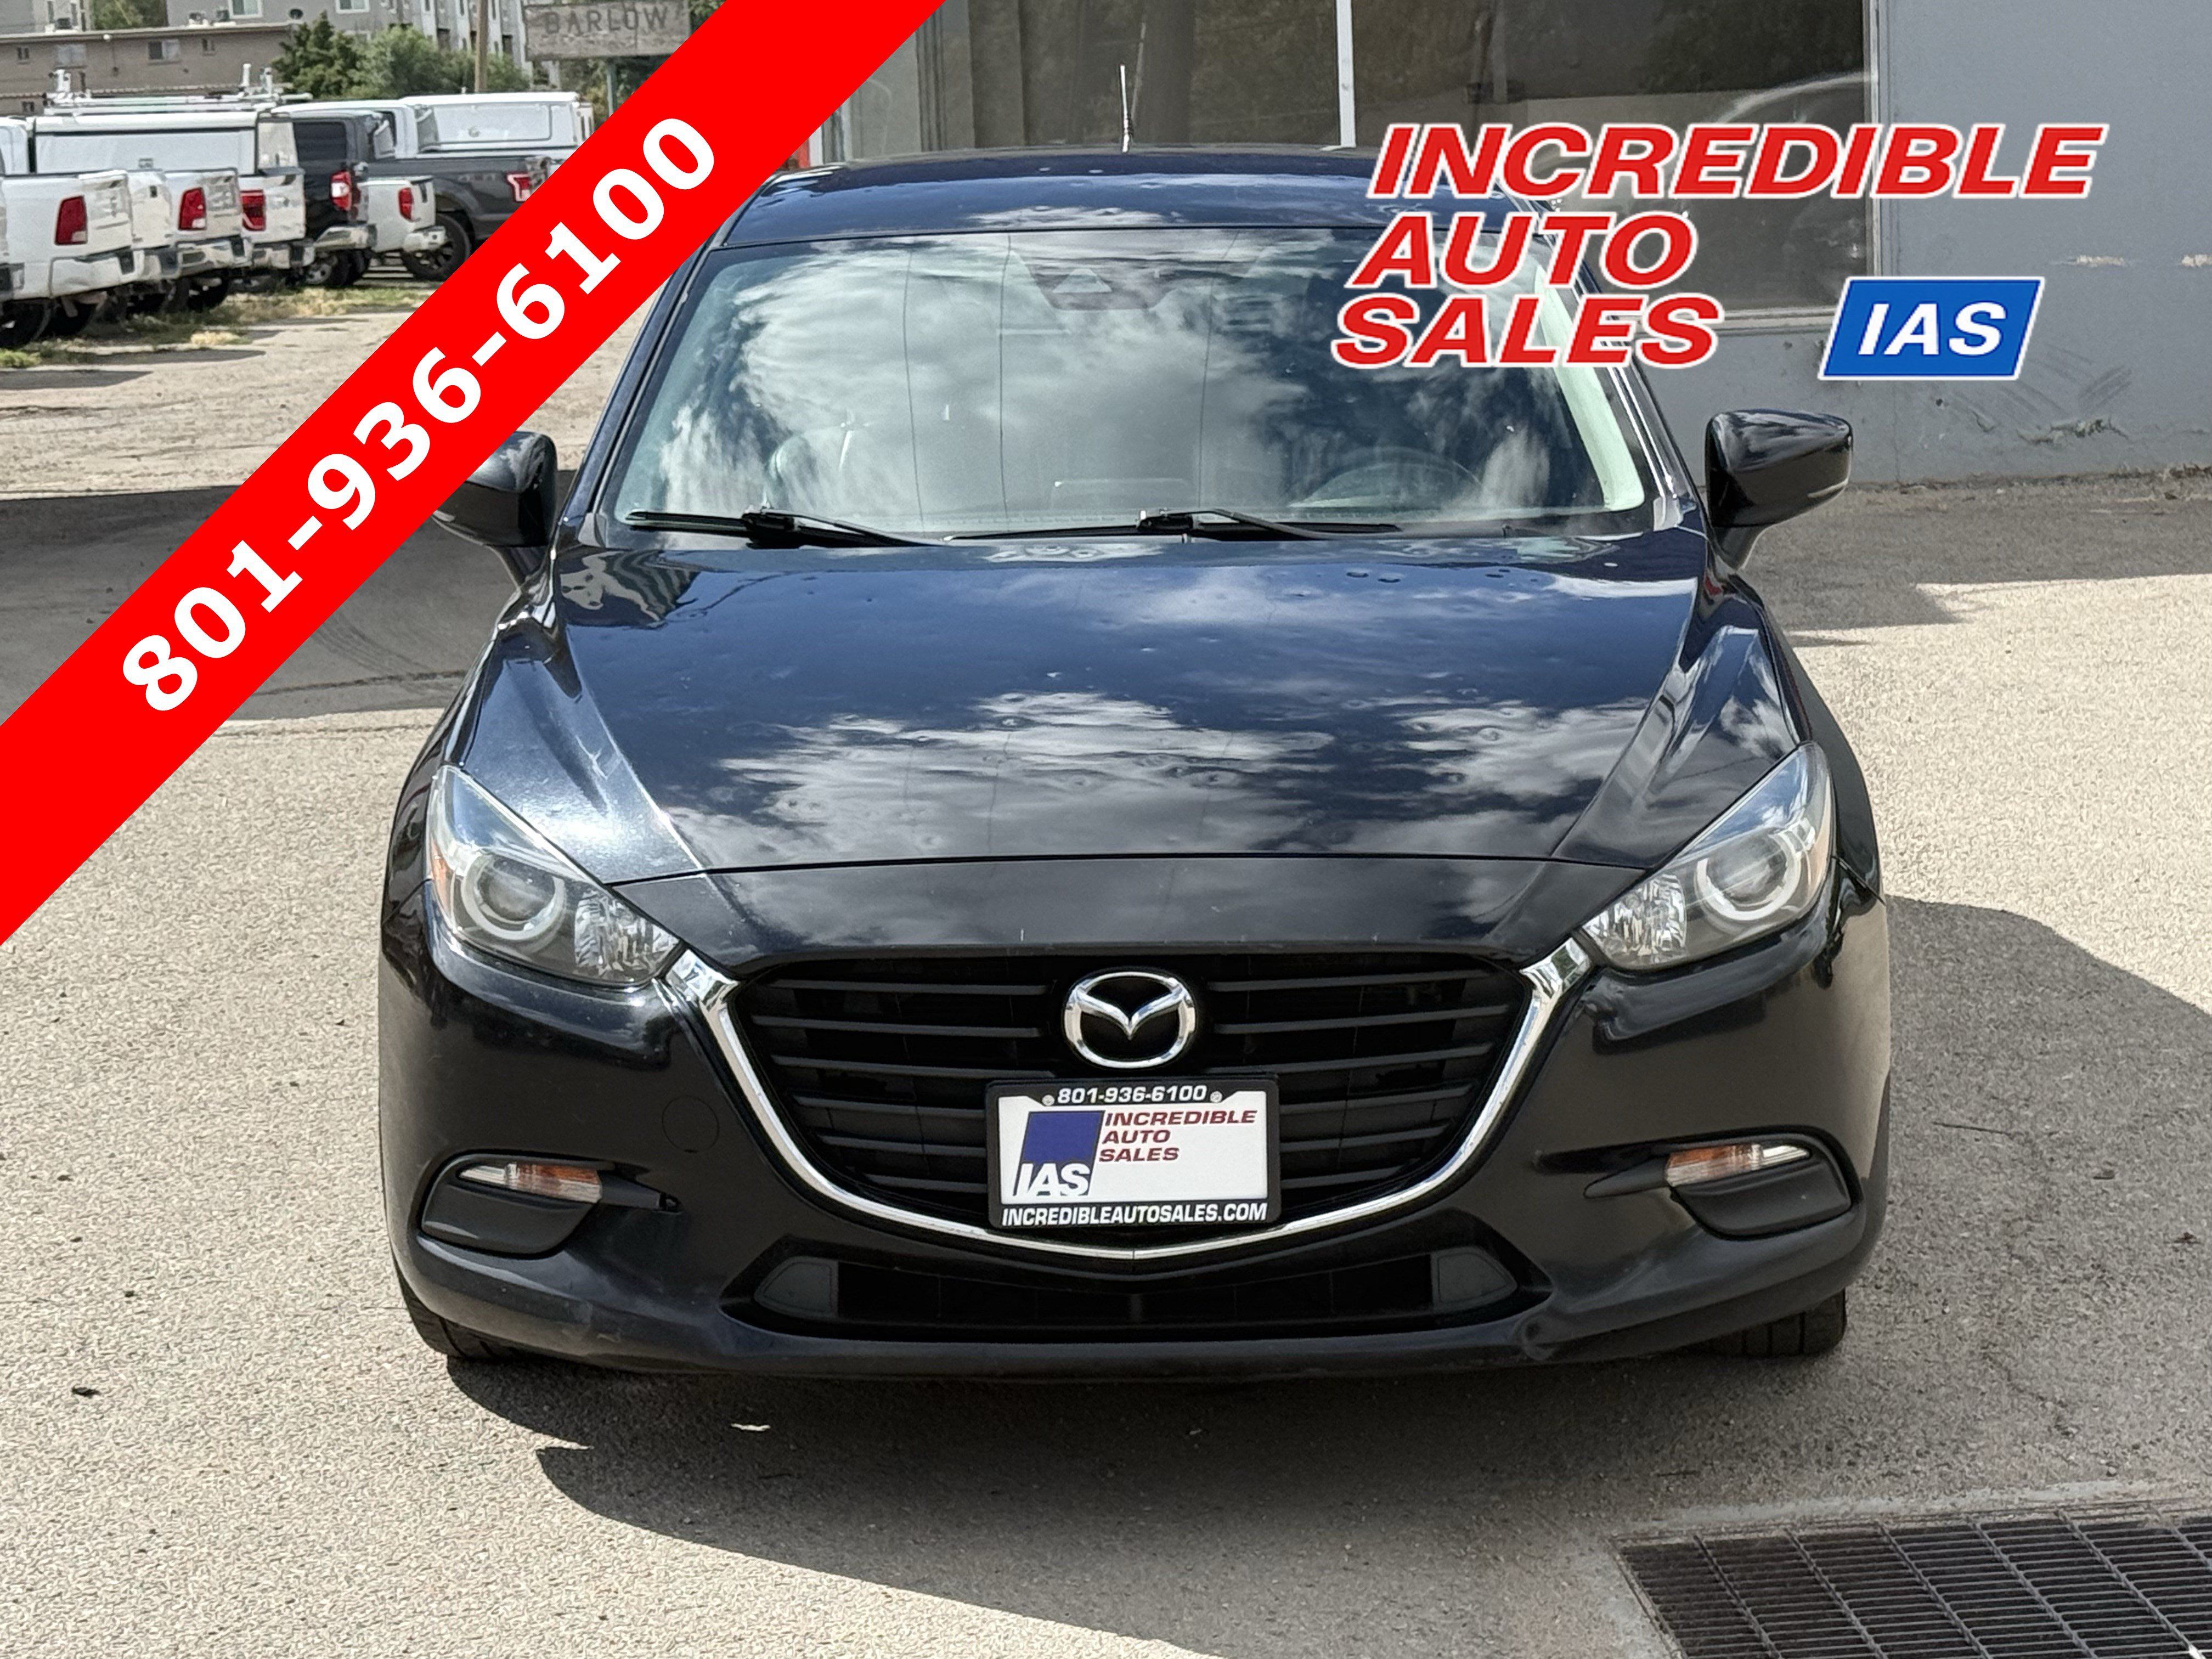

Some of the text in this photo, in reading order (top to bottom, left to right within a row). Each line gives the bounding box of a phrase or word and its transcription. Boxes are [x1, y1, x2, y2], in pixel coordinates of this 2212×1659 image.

[1057, 1085, 1207, 1104] 801-936-6100
[1104, 1109, 1258, 1127] INCREDIBLE
[1102, 1130, 1171, 1144] AUTO
[1098, 1147, 1180, 1163] SALES
[1016, 1162, 1092, 1197] IAS
[1001, 1202, 1268, 1227] INCREDIBLEAUTOSALES.COM
